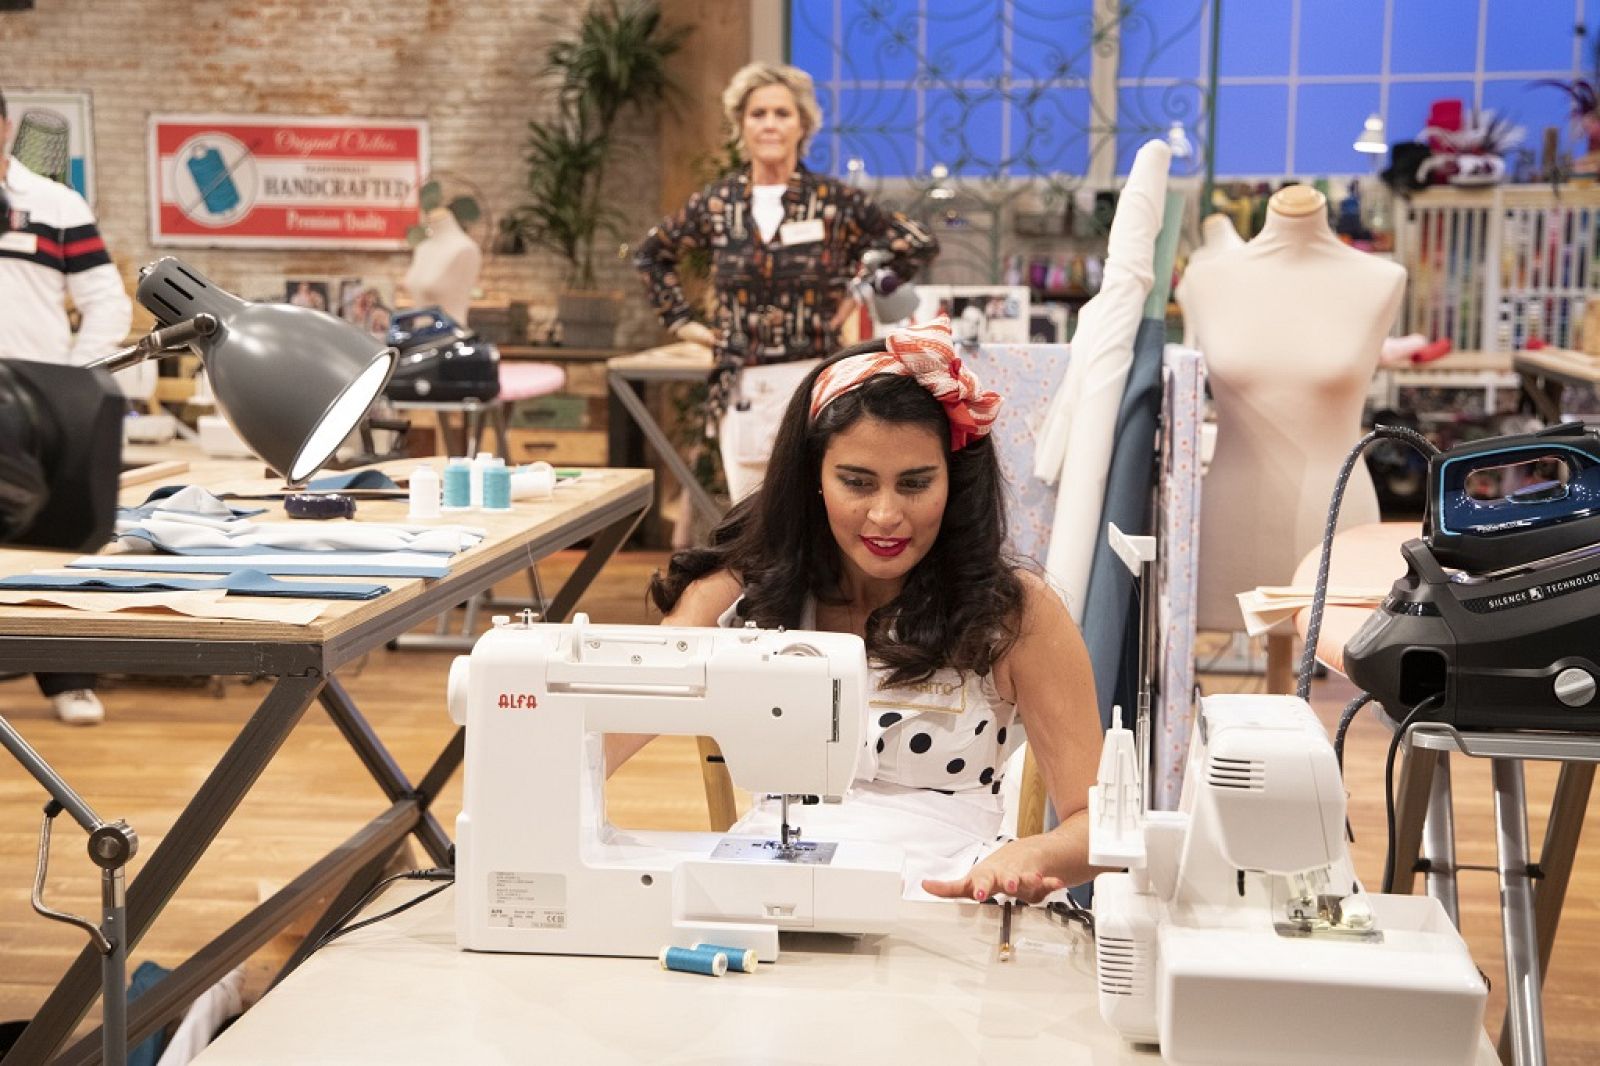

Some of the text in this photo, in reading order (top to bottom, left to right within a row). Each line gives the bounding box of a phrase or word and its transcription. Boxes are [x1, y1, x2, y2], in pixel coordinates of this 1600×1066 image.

[274, 129, 338, 157] Original
[263, 176, 410, 199] HANDCRAFTED
[286, 210, 387, 232] Premium Quality
[1488, 573, 1600, 608] SILENCE TECHNOLOG
[498, 693, 537, 709] ALFA
